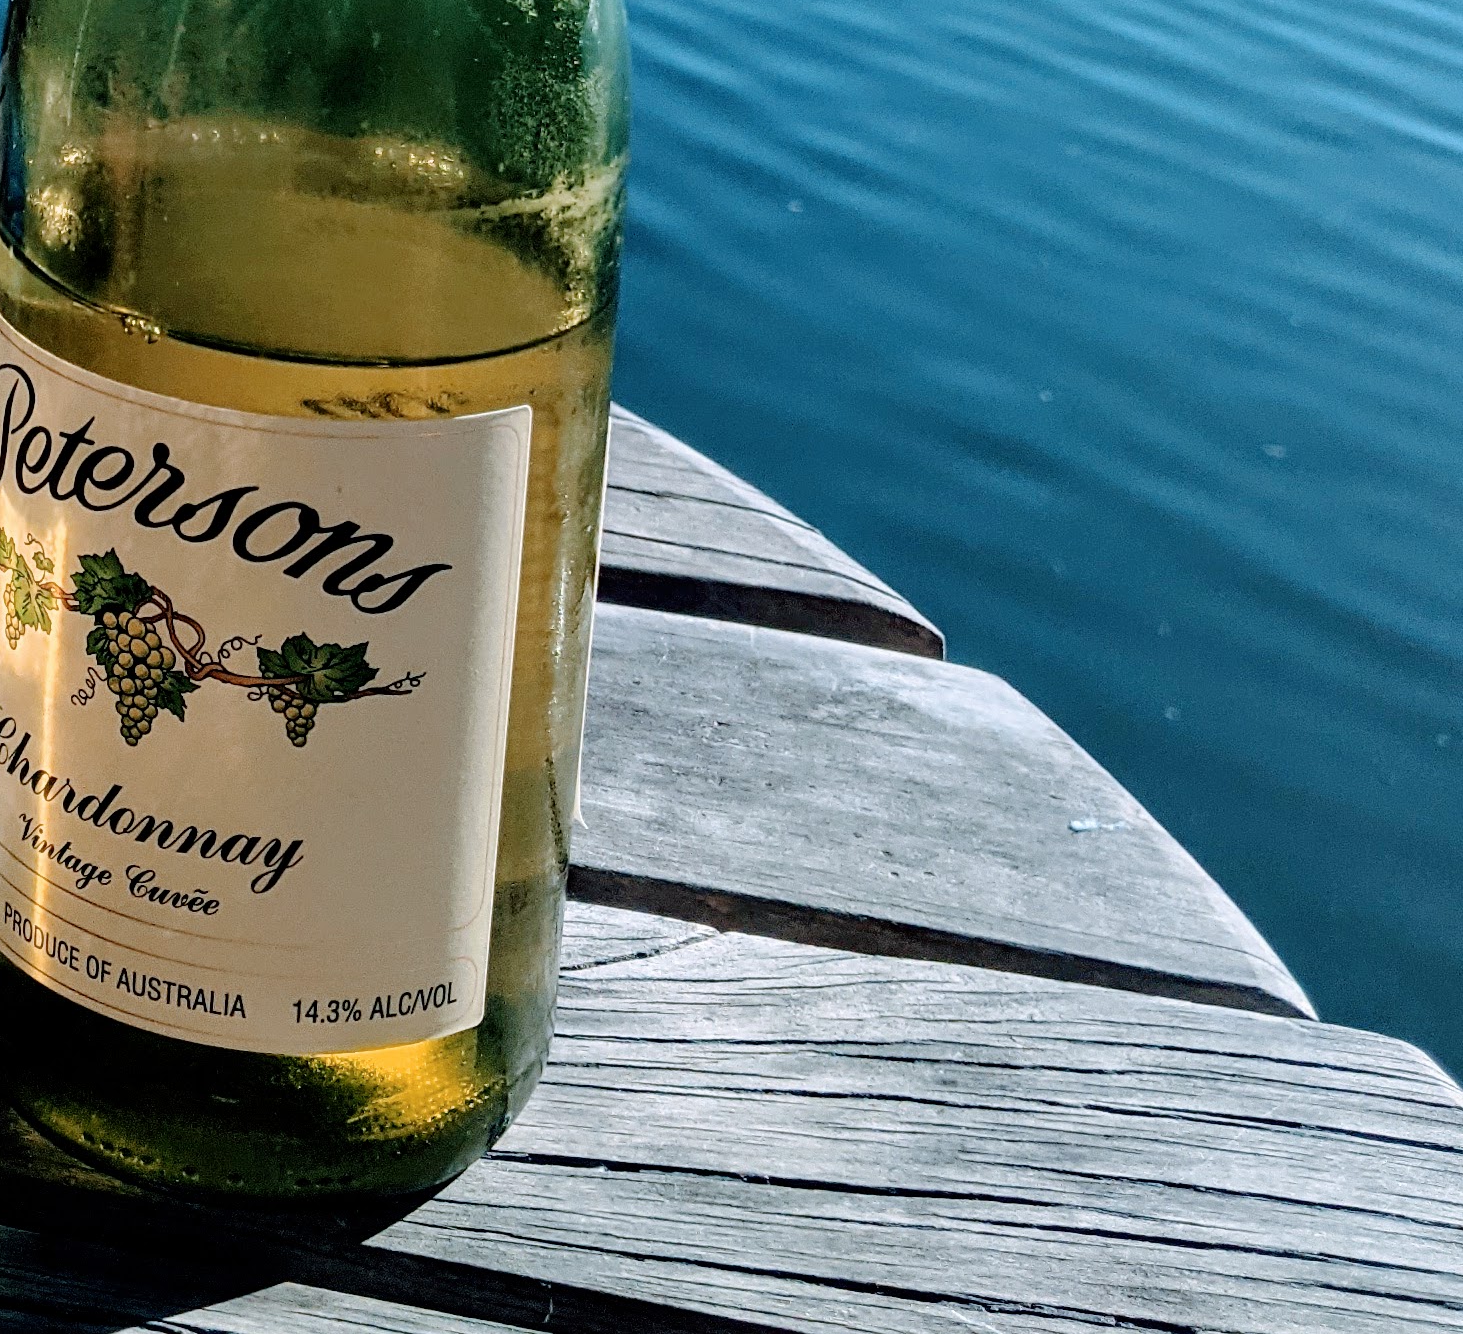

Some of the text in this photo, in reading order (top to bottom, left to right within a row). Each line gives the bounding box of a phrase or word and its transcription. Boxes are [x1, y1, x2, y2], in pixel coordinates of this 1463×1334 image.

[18, 813, 113, 890] Vintage
[3, 901, 247, 1019] PRODUCE OF AUSTRALIA
[292, 981, 458, 1024] 14.3% ALC/VOL
